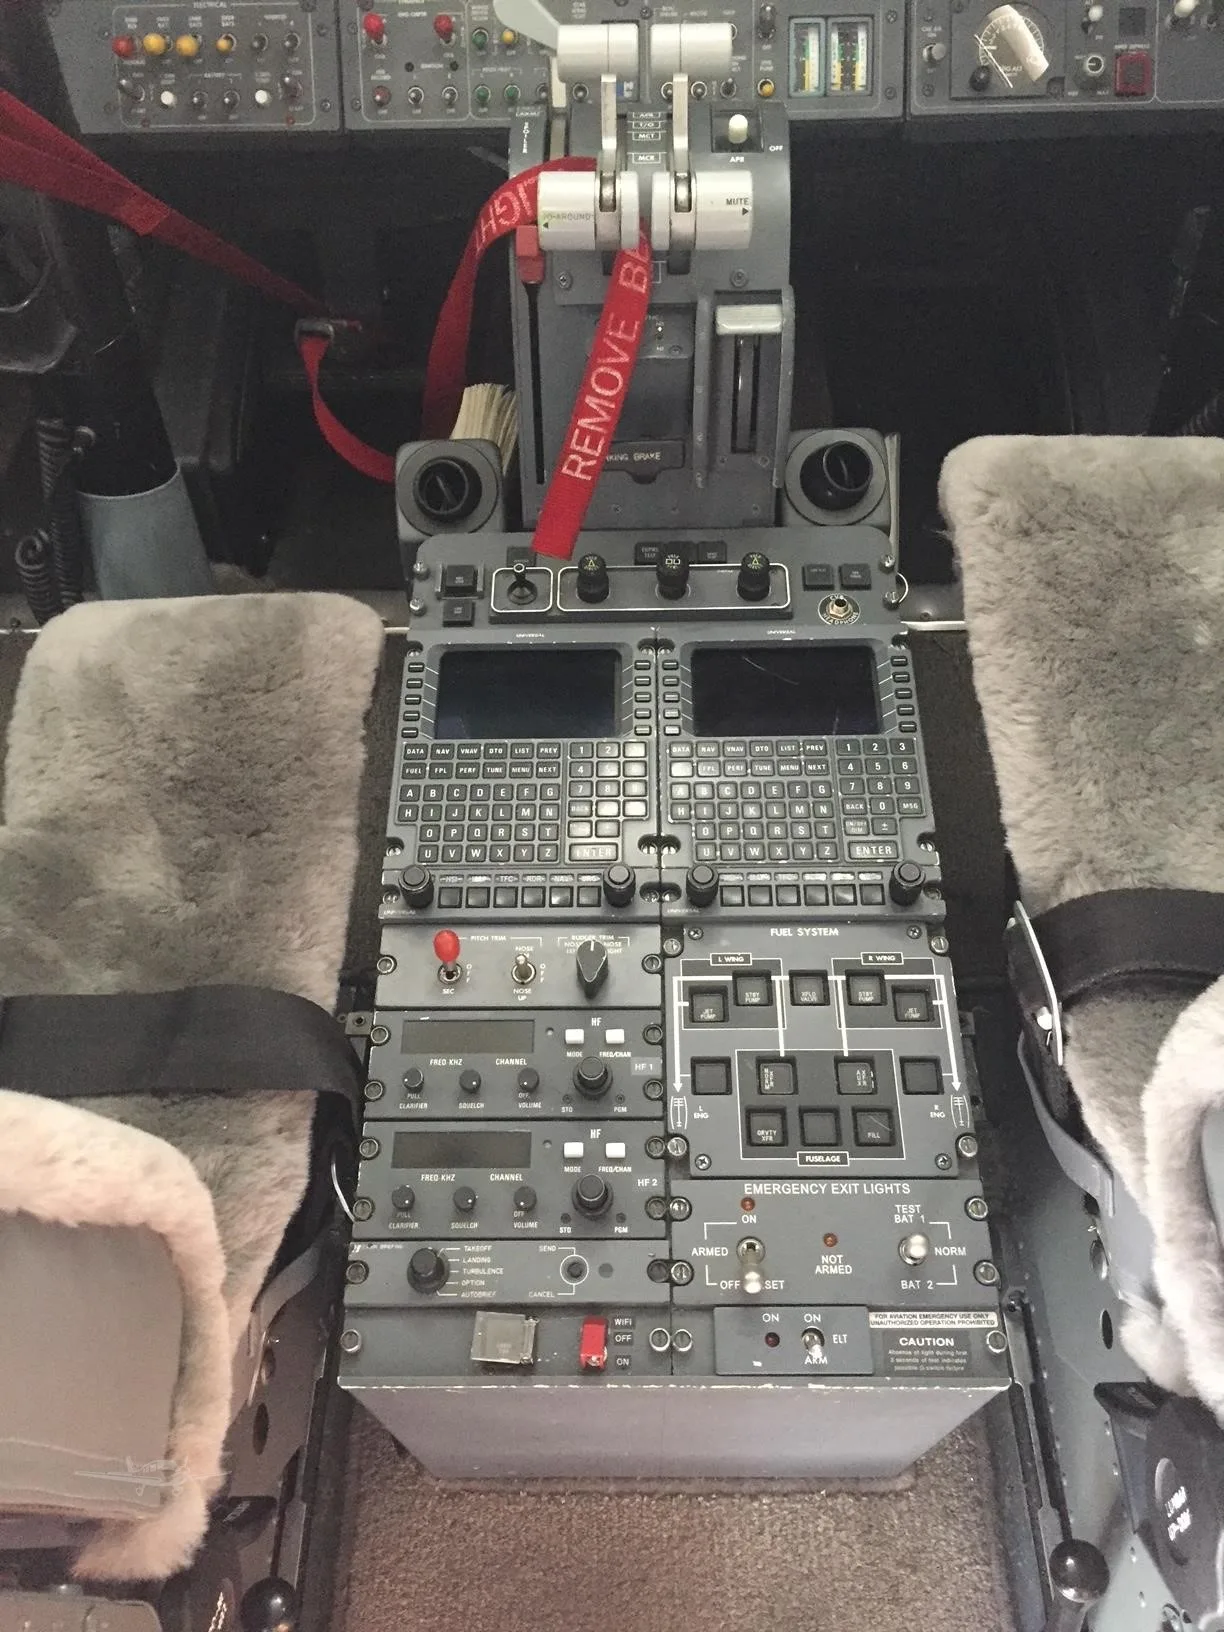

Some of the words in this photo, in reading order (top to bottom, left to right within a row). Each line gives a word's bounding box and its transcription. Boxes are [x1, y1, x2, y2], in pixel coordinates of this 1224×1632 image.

[561, 314, 642, 481] REMOVE
[633, 452, 661, 461] BRAKE
[872, 742, 878, 751] 2
[899, 742, 906, 751] 3
[847, 762, 854, 771] 4
[875, 762, 881, 771] 5
[902, 761, 909, 770] 6
[877, 781, 884, 790] 8
[904, 781, 911, 790] 9
[879, 801, 886, 811] 0
[855, 845, 892, 856] ENTER
[770, 928, 793, 937] FUEL
[797, 927, 839, 937] SYSTEM
[591, 1017, 602, 1026] HF
[495, 1058, 527, 1066] CHANNEL
[590, 1128, 601, 1139] HF
[441, 1173, 456, 1182] KHZ
[490, 1173, 523, 1181] CHANNEL
[637, 1178, 650, 1187] HF
[652, 1178, 658, 1186] 2
[744, 1183, 827, 1195] EMERGENCY
[831, 1183, 860, 1194] EXIT
[863, 1183, 911, 1194] LIGHTS
[895, 1204, 921, 1214] TEST
[741, 1214, 757, 1224] ON
[894, 1214, 914, 1224] BAT
[691, 1246, 729, 1257] ARMED
[934, 1246, 966, 1256] NORM
[821, 1254, 844, 1264] NOT
[815, 1264, 853, 1274] ARMED
[720, 1280, 740, 1290] OFF
[900, 1280, 921, 1290] BAT
[926, 1280, 934, 1290] 2
[762, 1313, 780, 1323] ON
[803, 1313, 821, 1323] ON
[615, 1334, 632, 1343] OFF
[832, 1334, 848, 1344] ELT
[899, 1337, 955, 1347] CAUTION
[616, 1357, 630, 1366] ON
[804, 1355, 828, 1365] ARM
